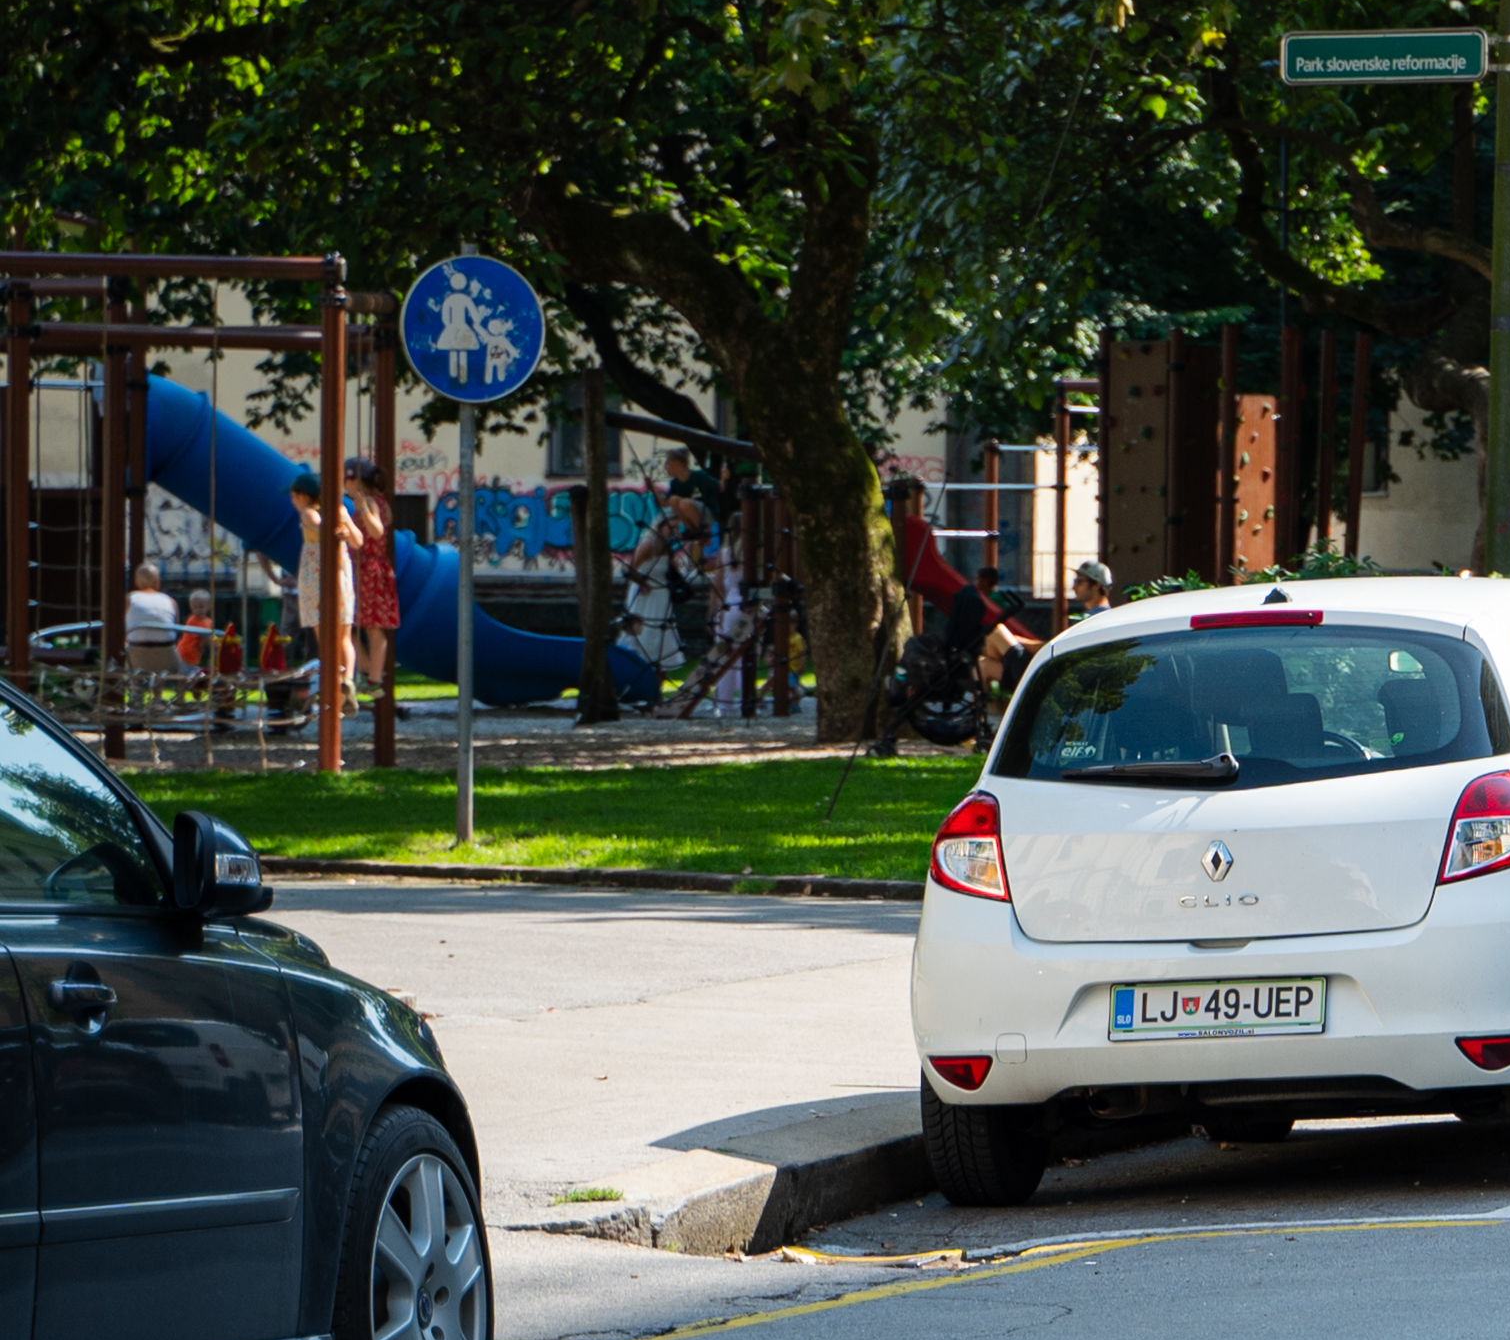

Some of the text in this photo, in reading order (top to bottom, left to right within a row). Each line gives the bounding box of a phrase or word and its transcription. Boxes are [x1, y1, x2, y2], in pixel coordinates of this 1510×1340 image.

[1295, 53, 1467, 74] Park slovenske reformacije
[1179, 893, 1259, 909] CLIO
[1141, 986, 1314, 1023] LJ 49-UEP
[1116, 1014, 1131, 1025] SLO
